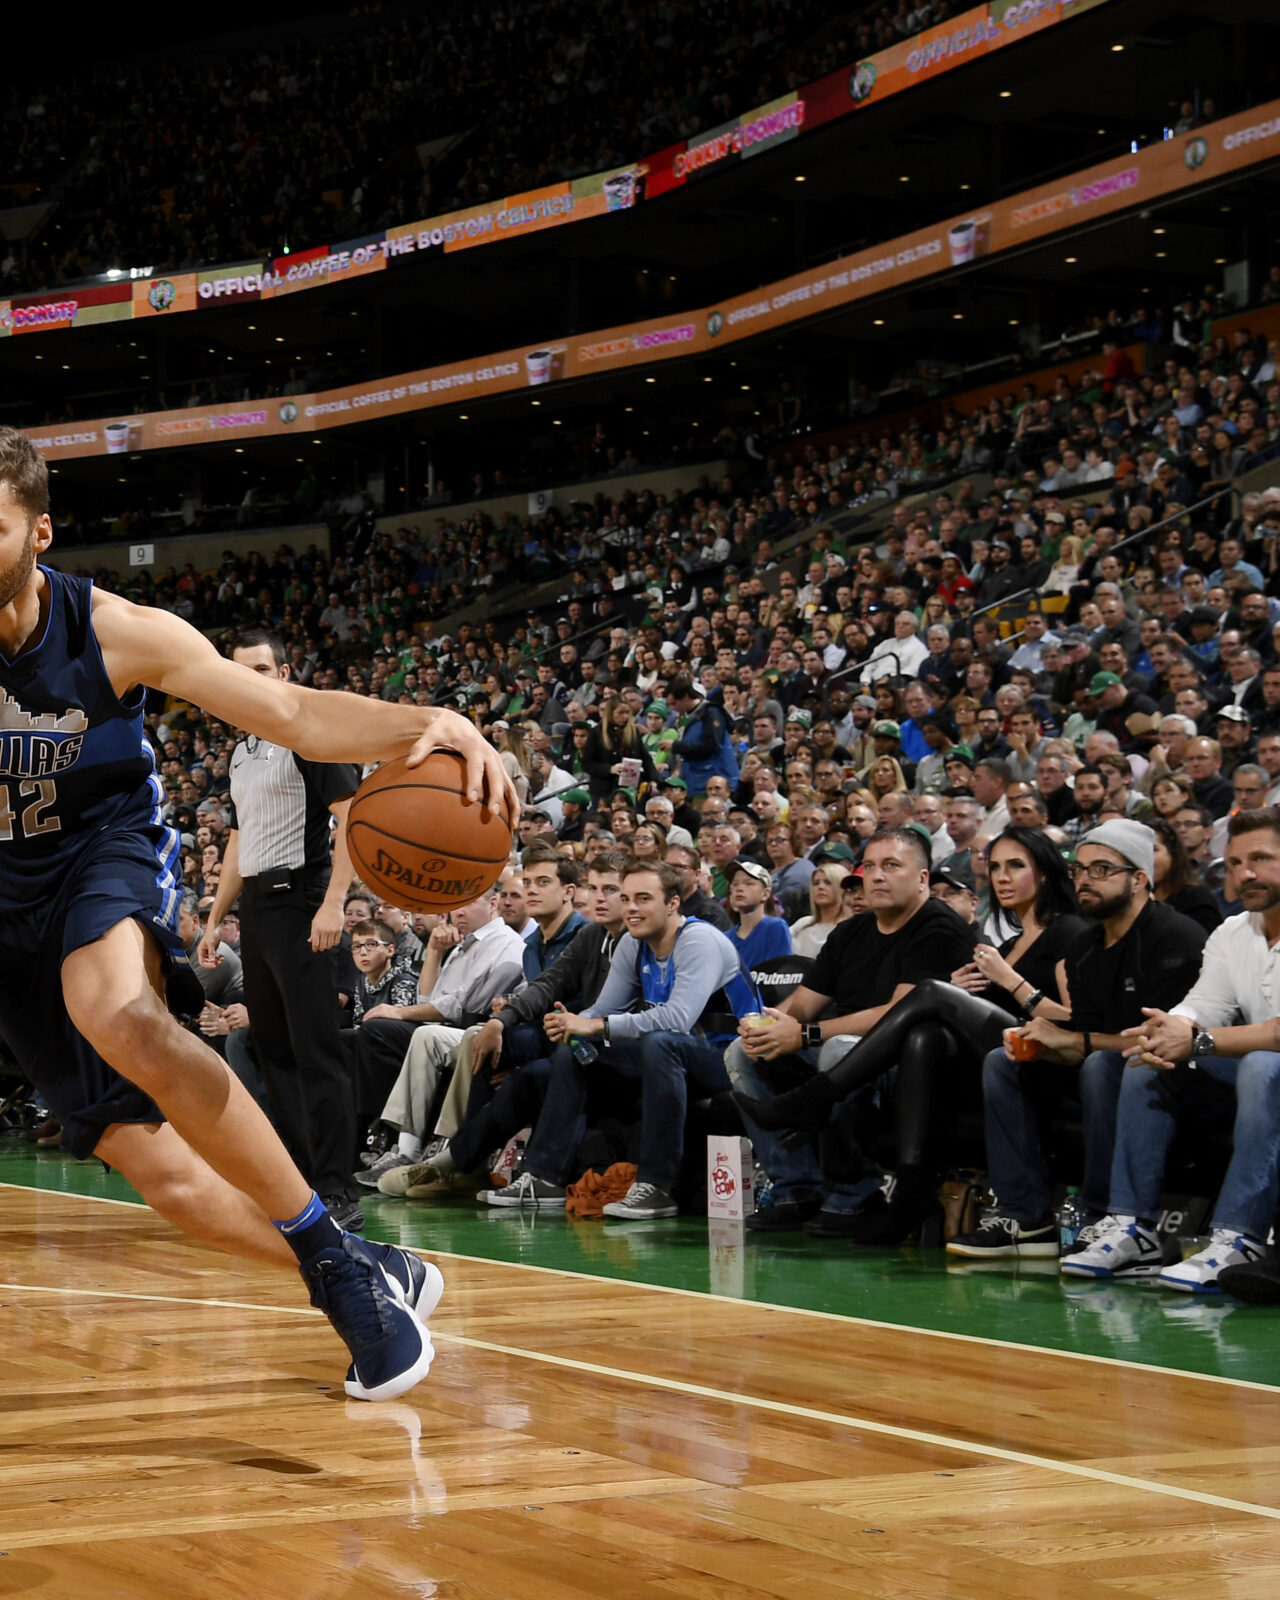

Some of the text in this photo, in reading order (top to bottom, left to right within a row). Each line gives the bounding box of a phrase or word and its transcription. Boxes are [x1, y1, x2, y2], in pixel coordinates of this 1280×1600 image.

[907, 16, 1000, 72] OFFICIAL
[198, 193, 575, 299] OFFICIAL COFFEE OF THE BOSTON CELTICS
[727, 239, 942, 325] OFFICIAL COFFEE OF THE BOSTON CELTICS
[11, 302, 78, 327] DONUTS
[641, 324, 695, 348] DONUTS
[304, 362, 519, 417] OFFICIAL COFFEE OF THE BOSTON CELTICS
[218, 410, 268, 428] DONUTS
[54, 432, 98, 446] CELTICS
[137, 548, 145, 562] 9
[371, 849, 484, 896] SPALDING
[756, 972, 804, 985] Putnam
